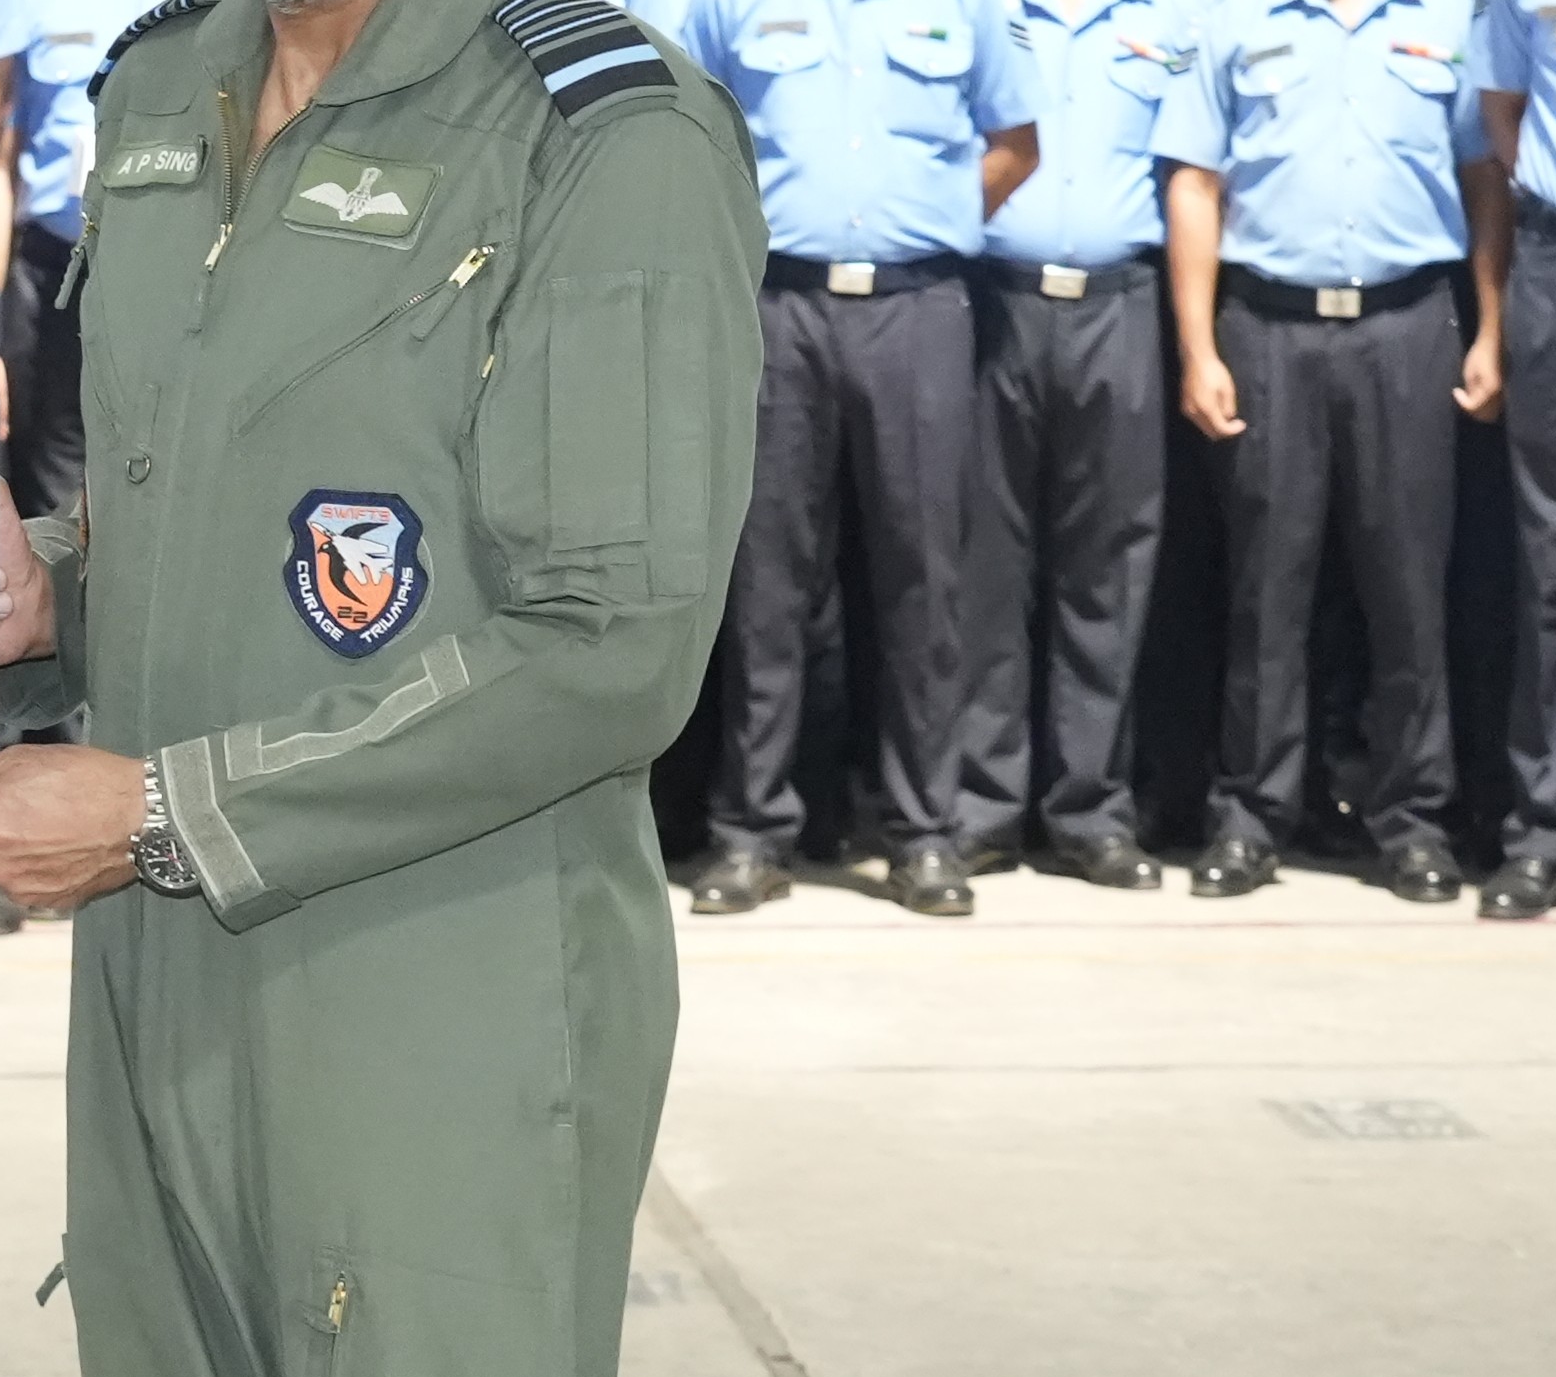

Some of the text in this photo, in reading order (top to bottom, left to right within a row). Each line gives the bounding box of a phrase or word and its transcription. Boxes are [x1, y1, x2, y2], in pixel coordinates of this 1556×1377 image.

[117, 156, 133, 175] A
[136, 153, 151, 173] P
[320, 504, 392, 523] SWIFTS
[297, 560, 414, 643] COURAGE TRIUMPHS
[337, 605, 371, 624] 22
